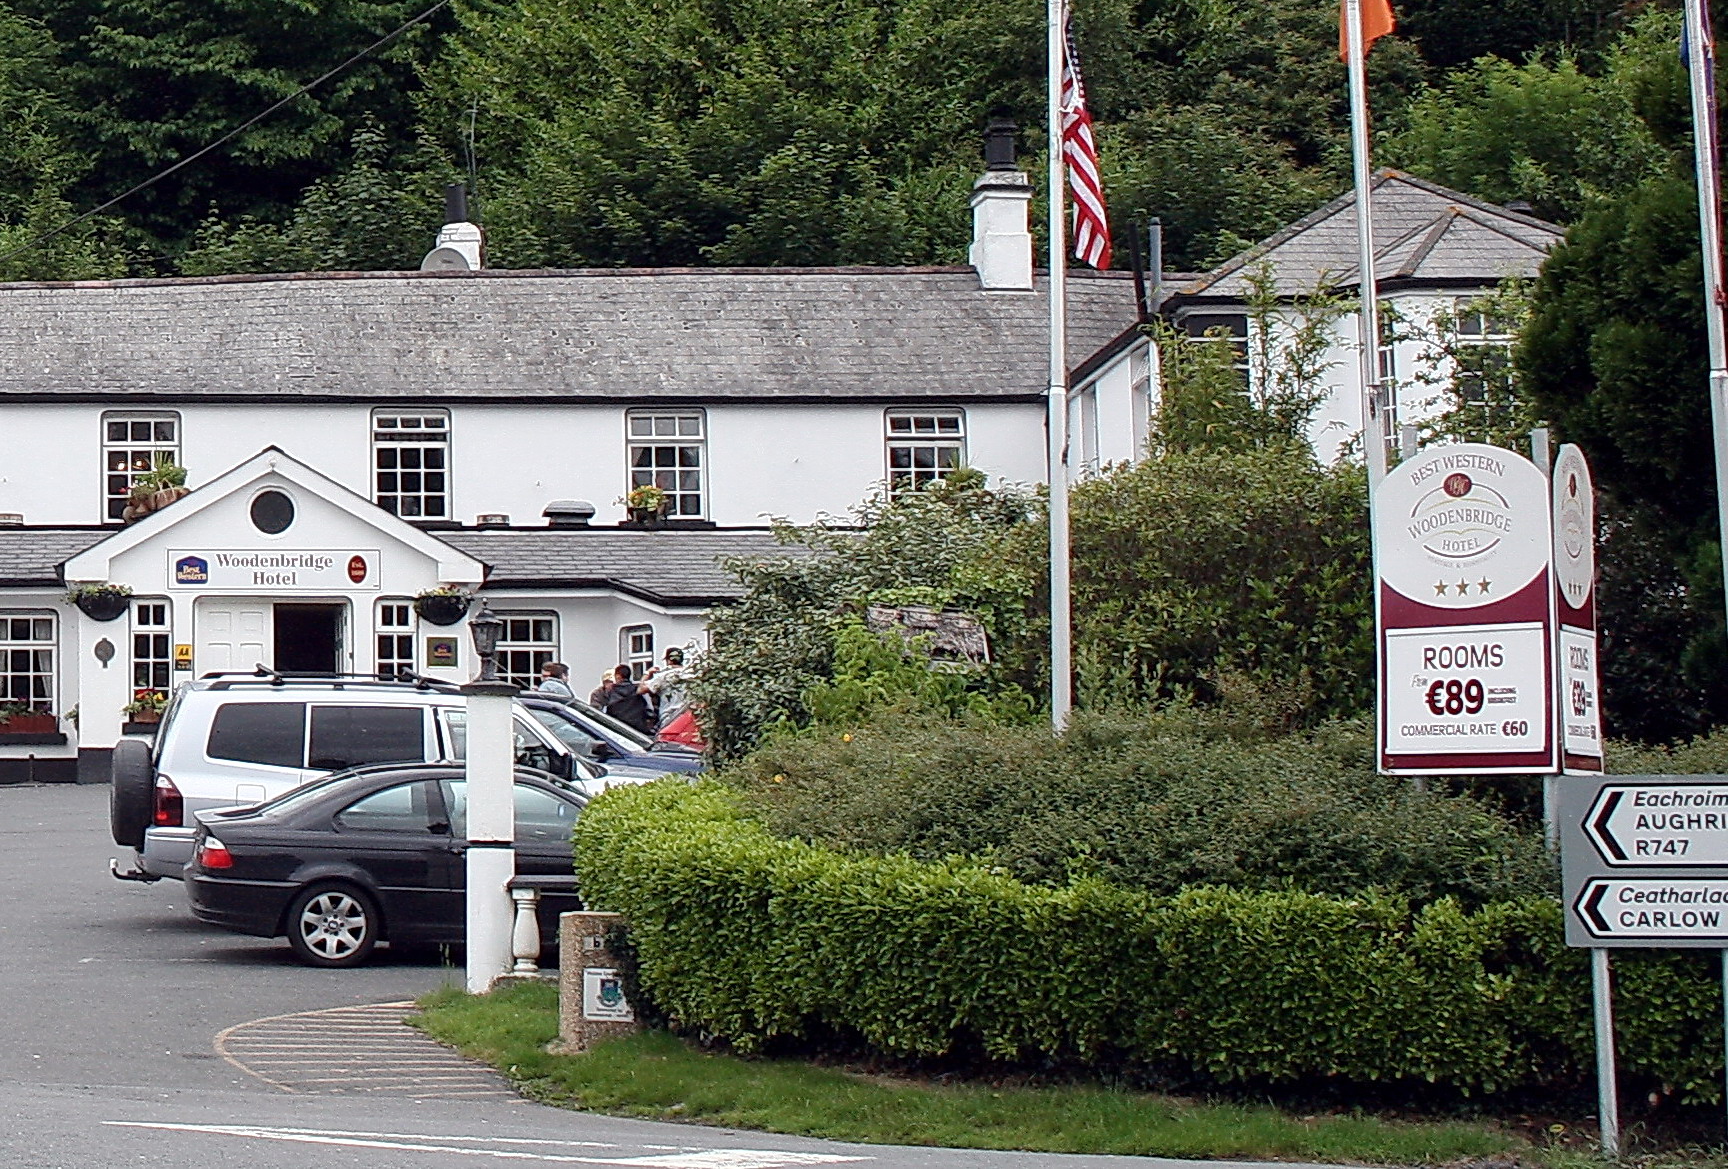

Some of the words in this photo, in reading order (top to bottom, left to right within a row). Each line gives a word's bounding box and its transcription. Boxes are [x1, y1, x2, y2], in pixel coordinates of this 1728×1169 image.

[1411, 459, 1440, 486] BEST
[1442, 454, 1505, 477] WESTERN
[1407, 508, 1512, 539] WOODENBRIDGE
[1441, 537, 1480, 552] HOTEL
[216, 553, 333, 571] Woodenbridge
[253, 572, 297, 585] Hotel
[1423, 644, 1504, 669] ROOMS
[1425, 679, 1484, 715] €89
[1401, 724, 1468, 736] COMMERCIAL
[1469, 723, 1497, 735] RATE
[1502, 721, 1528, 736] €60
[1633, 790, 1728, 807] Eachroim
[1636, 839, 1689, 855] R747
[1619, 911, 1720, 927] CARLOW
